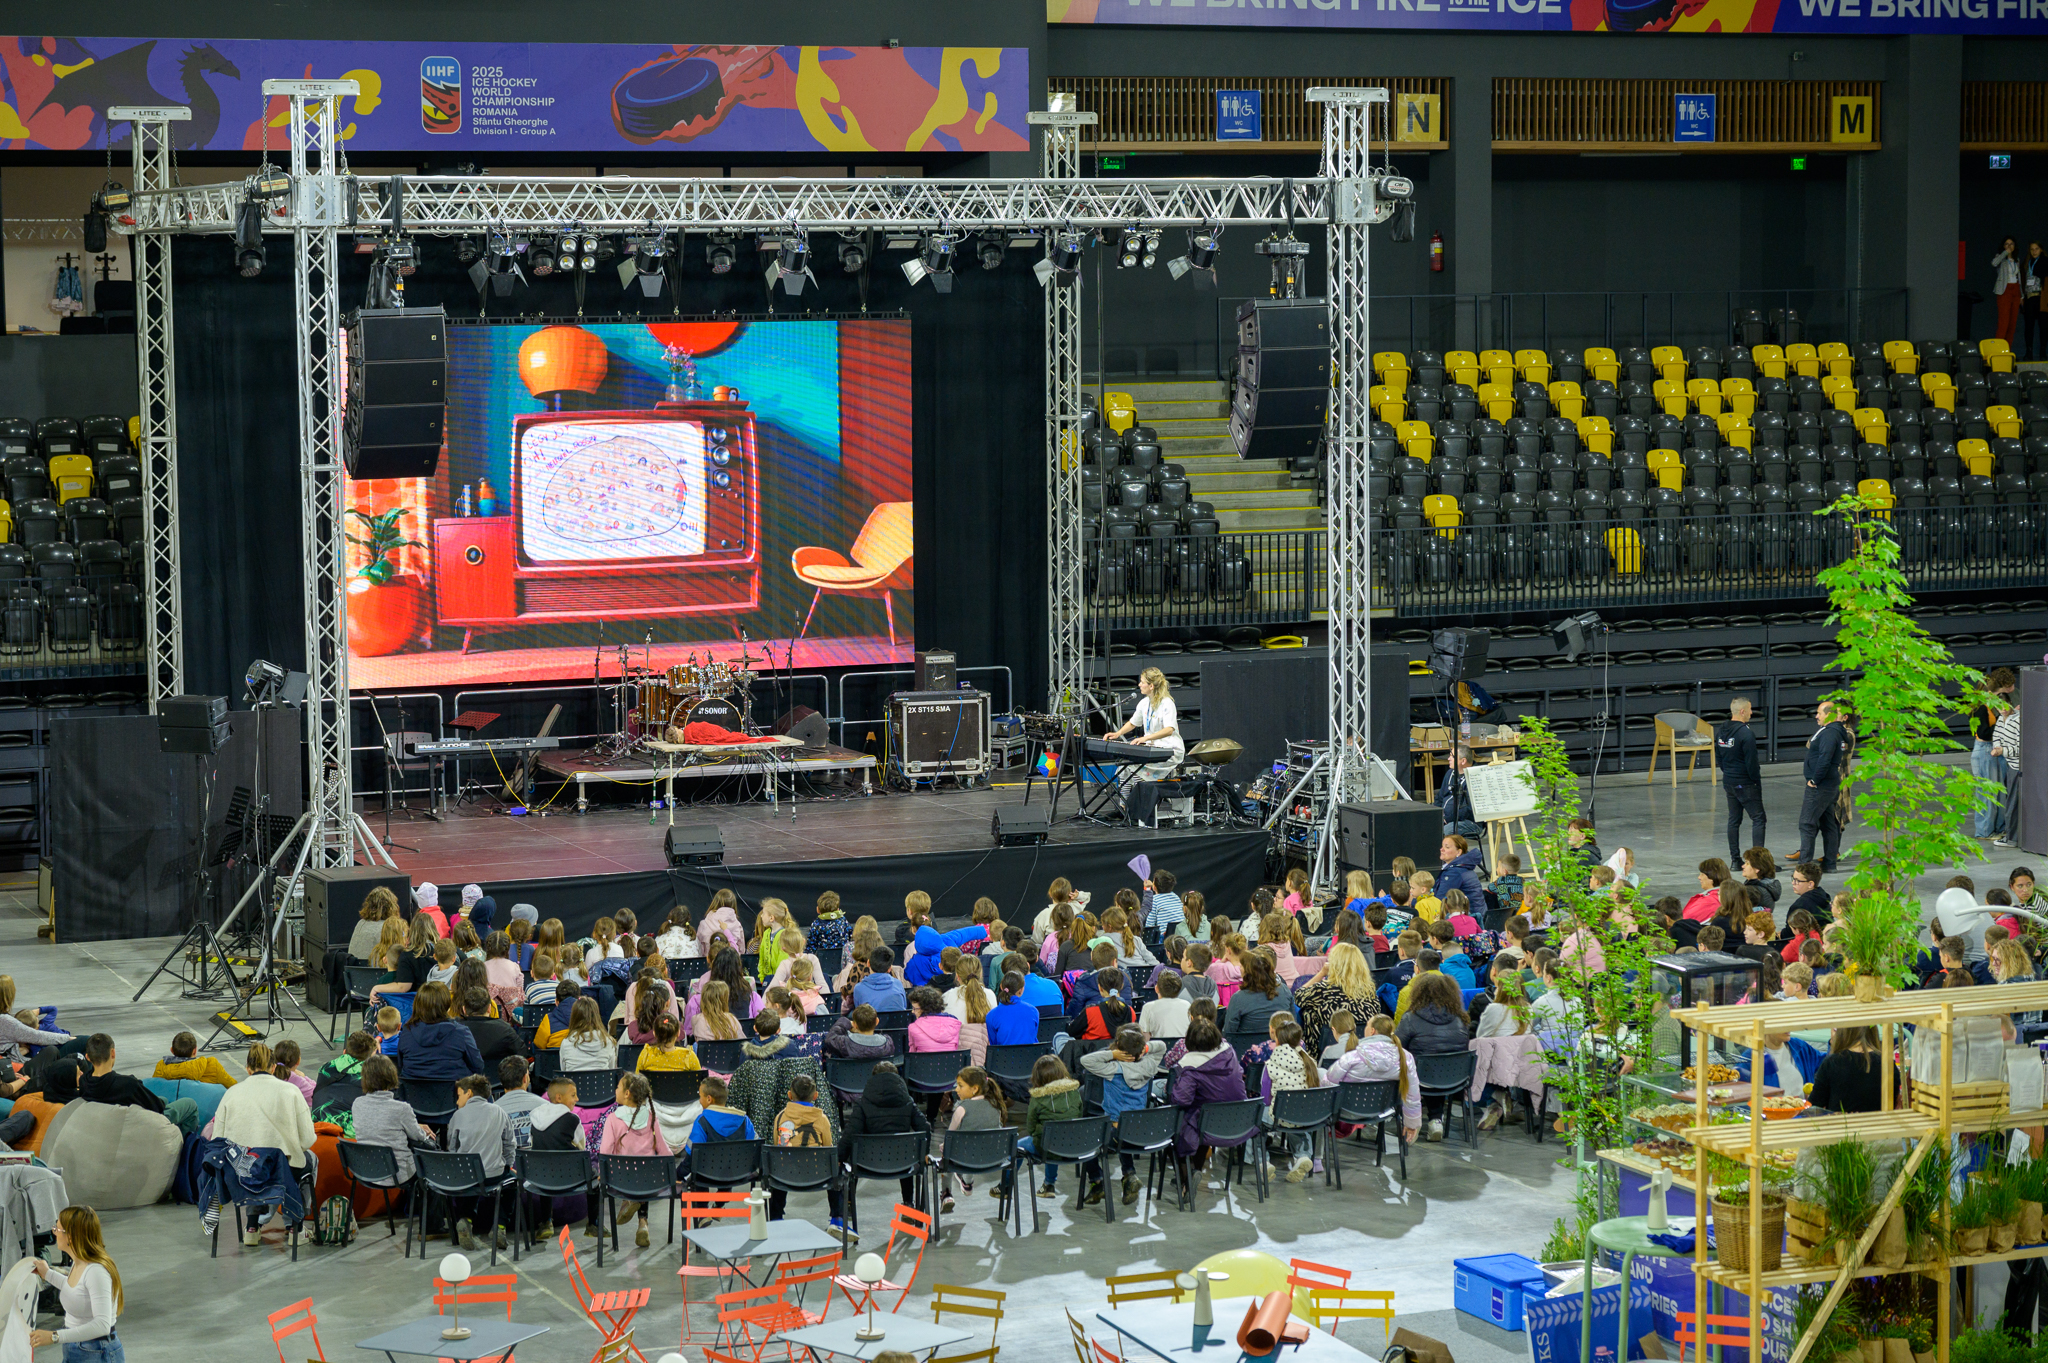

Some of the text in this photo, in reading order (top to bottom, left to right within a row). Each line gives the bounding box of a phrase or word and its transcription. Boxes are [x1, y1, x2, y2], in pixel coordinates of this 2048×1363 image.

[427, 65, 455, 77] IIHF
[472, 66, 503, 77] 2025
[472, 78, 538, 87] ICE HOCKEY
[472, 88, 512, 96] WORLD
[472, 97, 555, 106] CHAMPIONSHIP
[472, 107, 518, 116] ROMANIA
[1407, 101, 1429, 133] N
[1840, 104, 1865, 134] M
[472, 117, 548, 127] Sfântu Gheorghe
[473, 127, 507, 135] Division
[520, 127, 547, 136] Group
[549, 127, 556, 135] A
